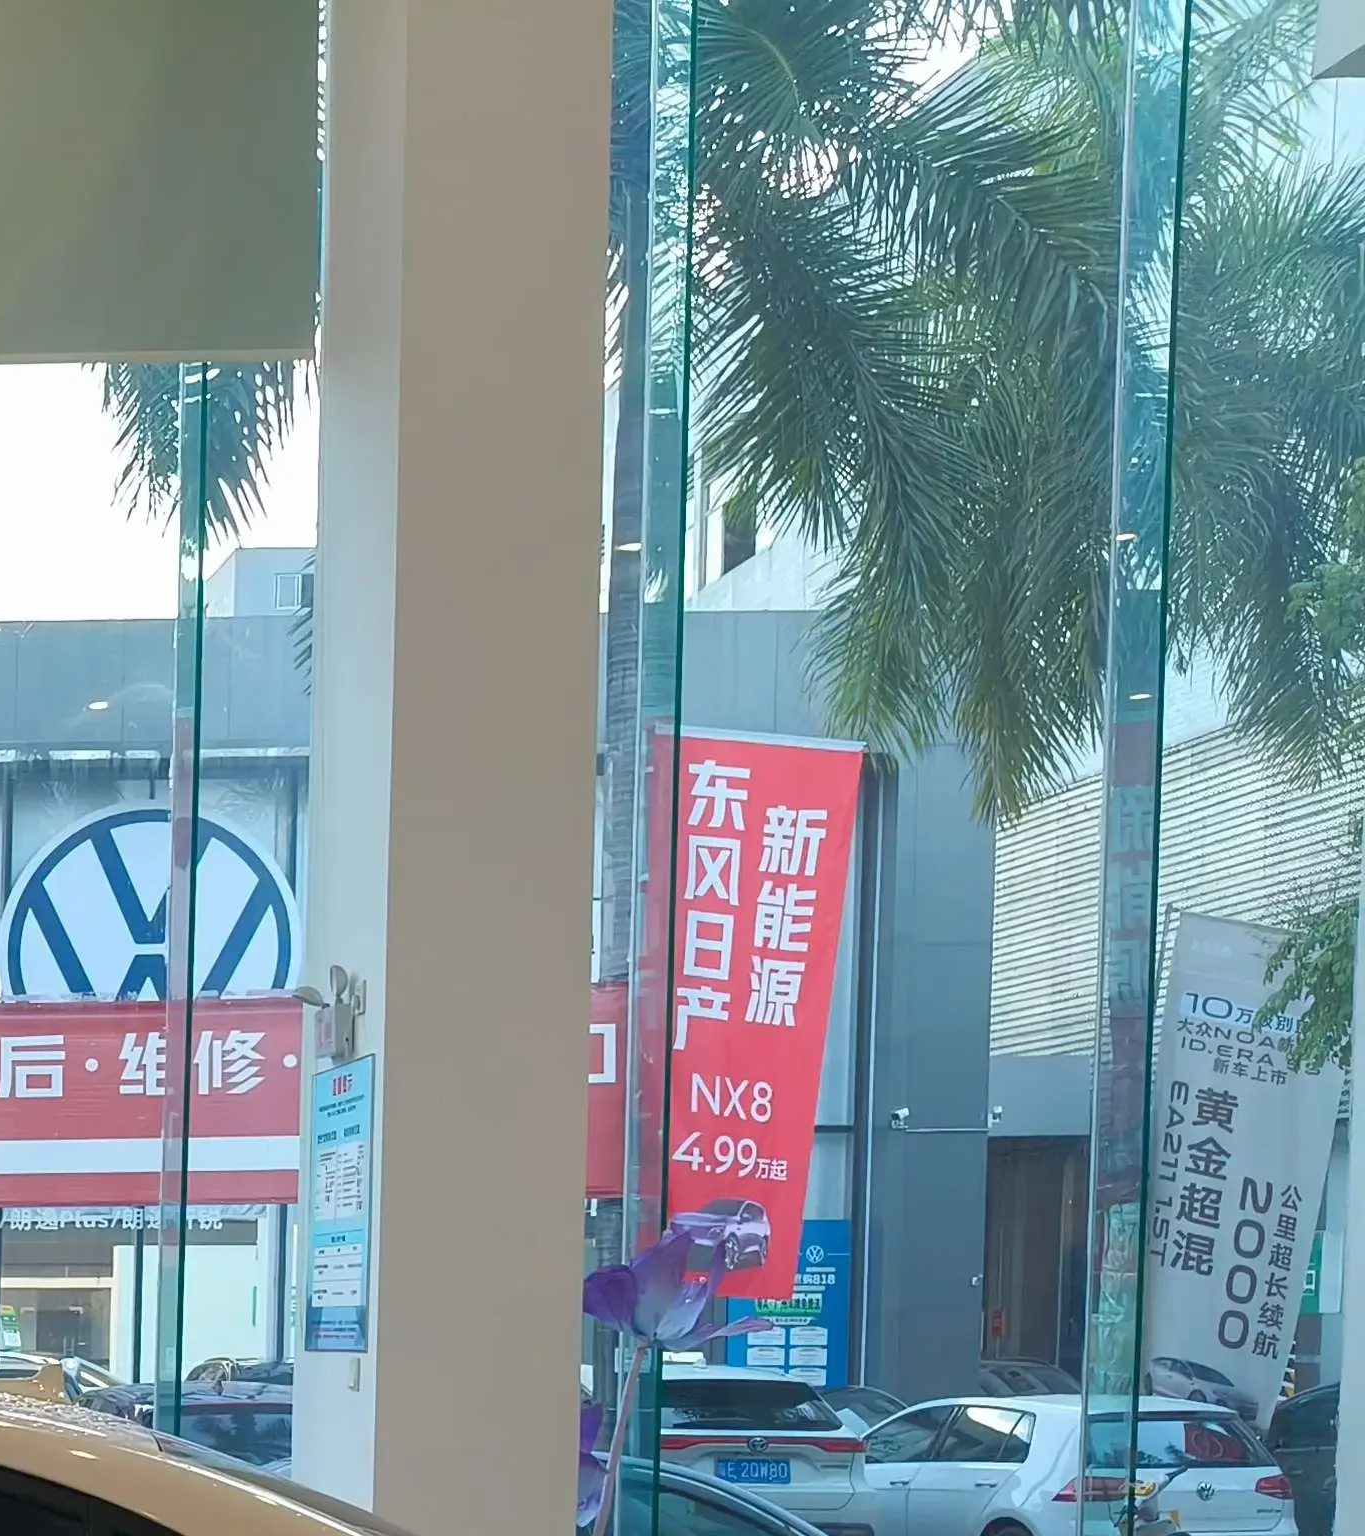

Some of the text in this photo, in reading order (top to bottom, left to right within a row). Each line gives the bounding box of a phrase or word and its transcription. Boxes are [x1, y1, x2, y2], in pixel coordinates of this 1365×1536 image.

[673, 760, 751, 1050] 东风日产
[745, 805, 827, 1027] 新能源
[690, 1073, 773, 1125] NX8
[1212, 1058, 1288, 1086] 新车上市
[1170, 1086, 1239, 1277] 黄金超混
[1218, 1176, 1273, 1350] 2000
[1252, 1184, 1302, 1360] 公里超长续航
